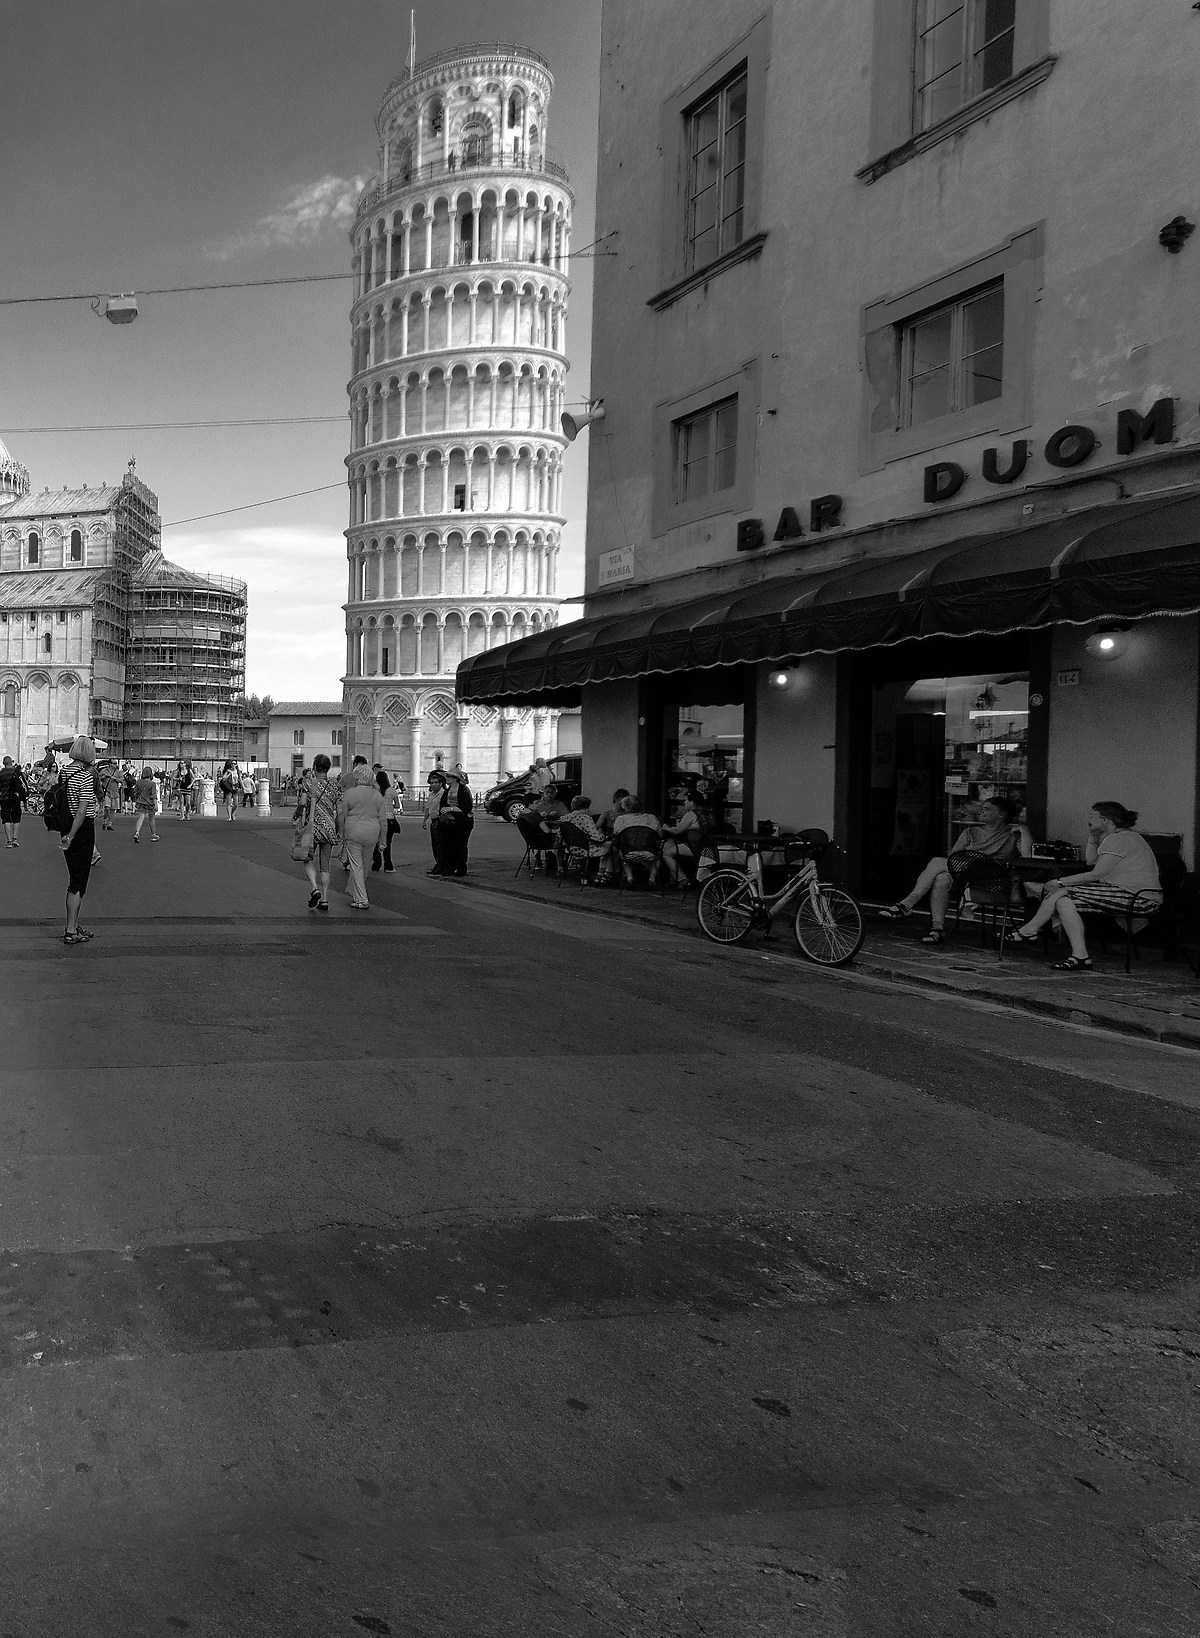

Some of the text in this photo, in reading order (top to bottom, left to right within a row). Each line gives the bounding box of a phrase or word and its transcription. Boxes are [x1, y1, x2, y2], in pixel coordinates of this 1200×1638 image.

[737, 397, 1200, 552] BAR DUOM
[609, 554, 623, 564] VIA
[607, 565, 631, 579] MARIA
